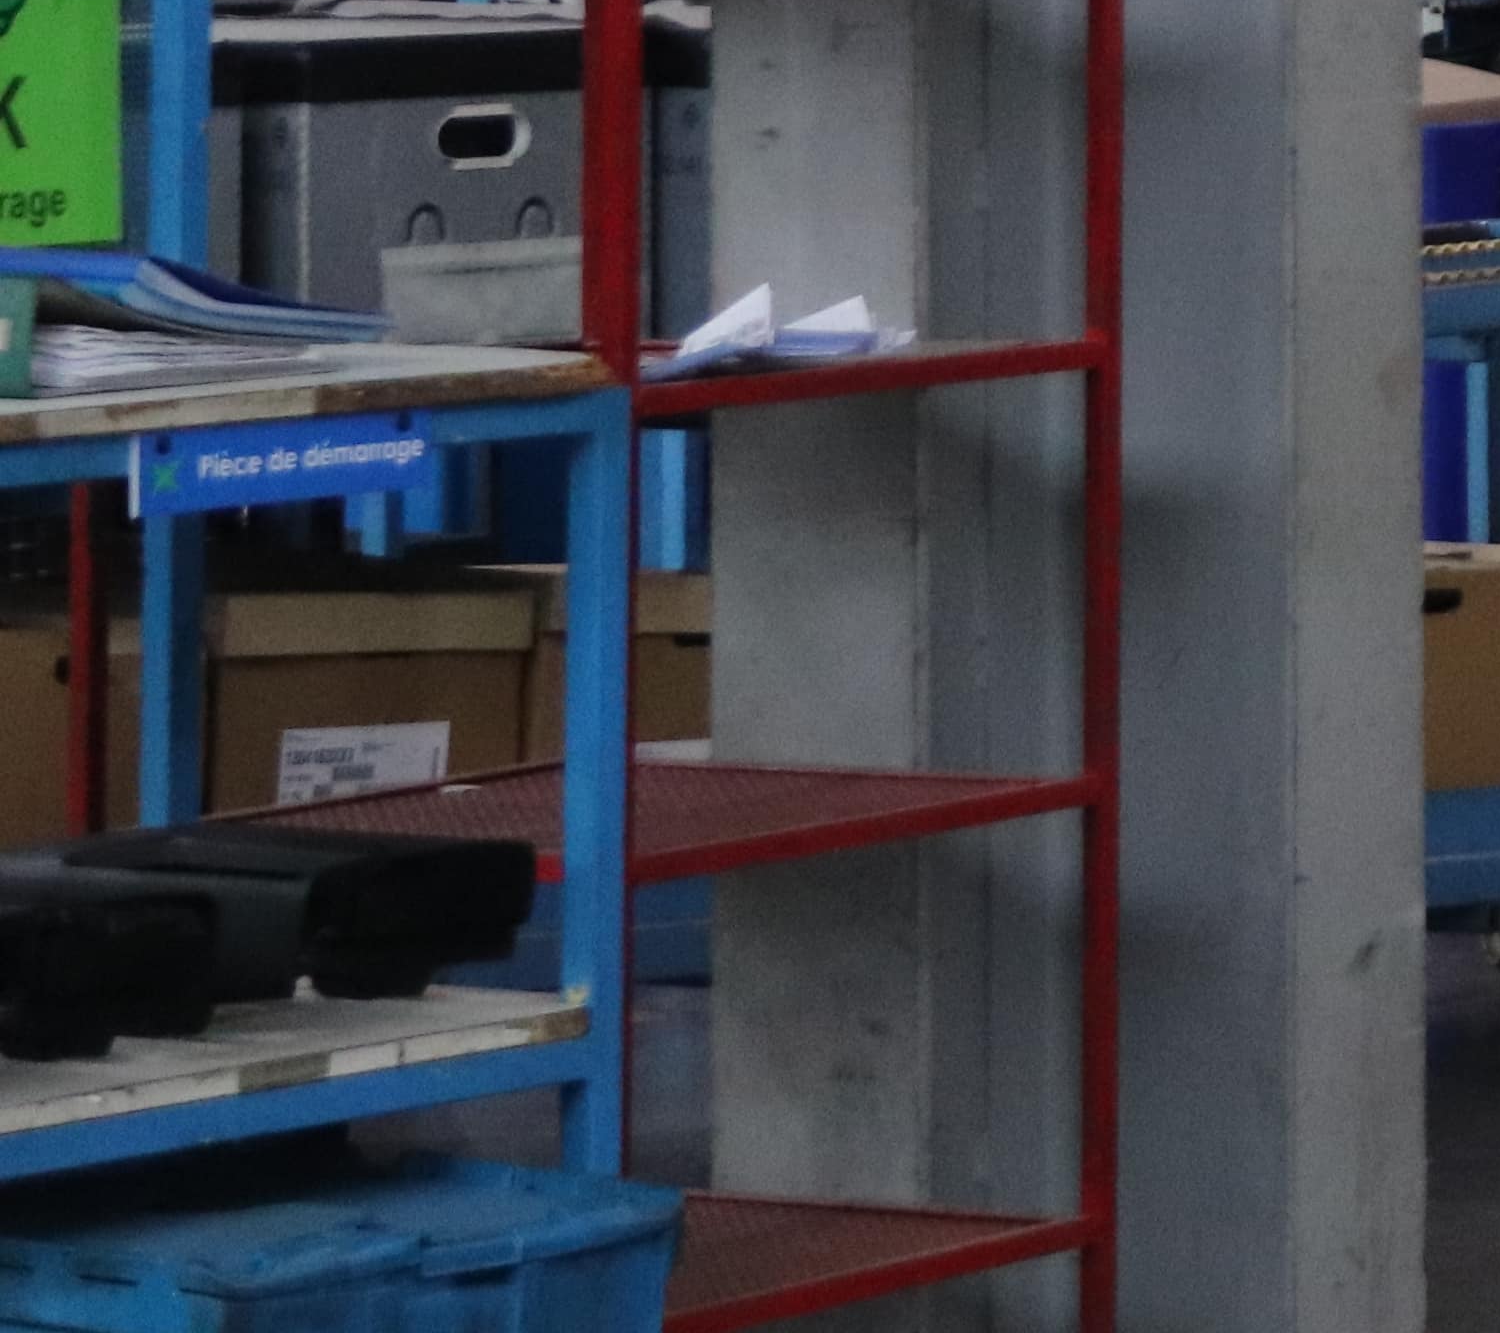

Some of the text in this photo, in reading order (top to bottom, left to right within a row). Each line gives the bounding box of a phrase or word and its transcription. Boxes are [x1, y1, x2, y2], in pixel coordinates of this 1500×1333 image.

[199, 437, 425, 479] Pièce de démarrage
